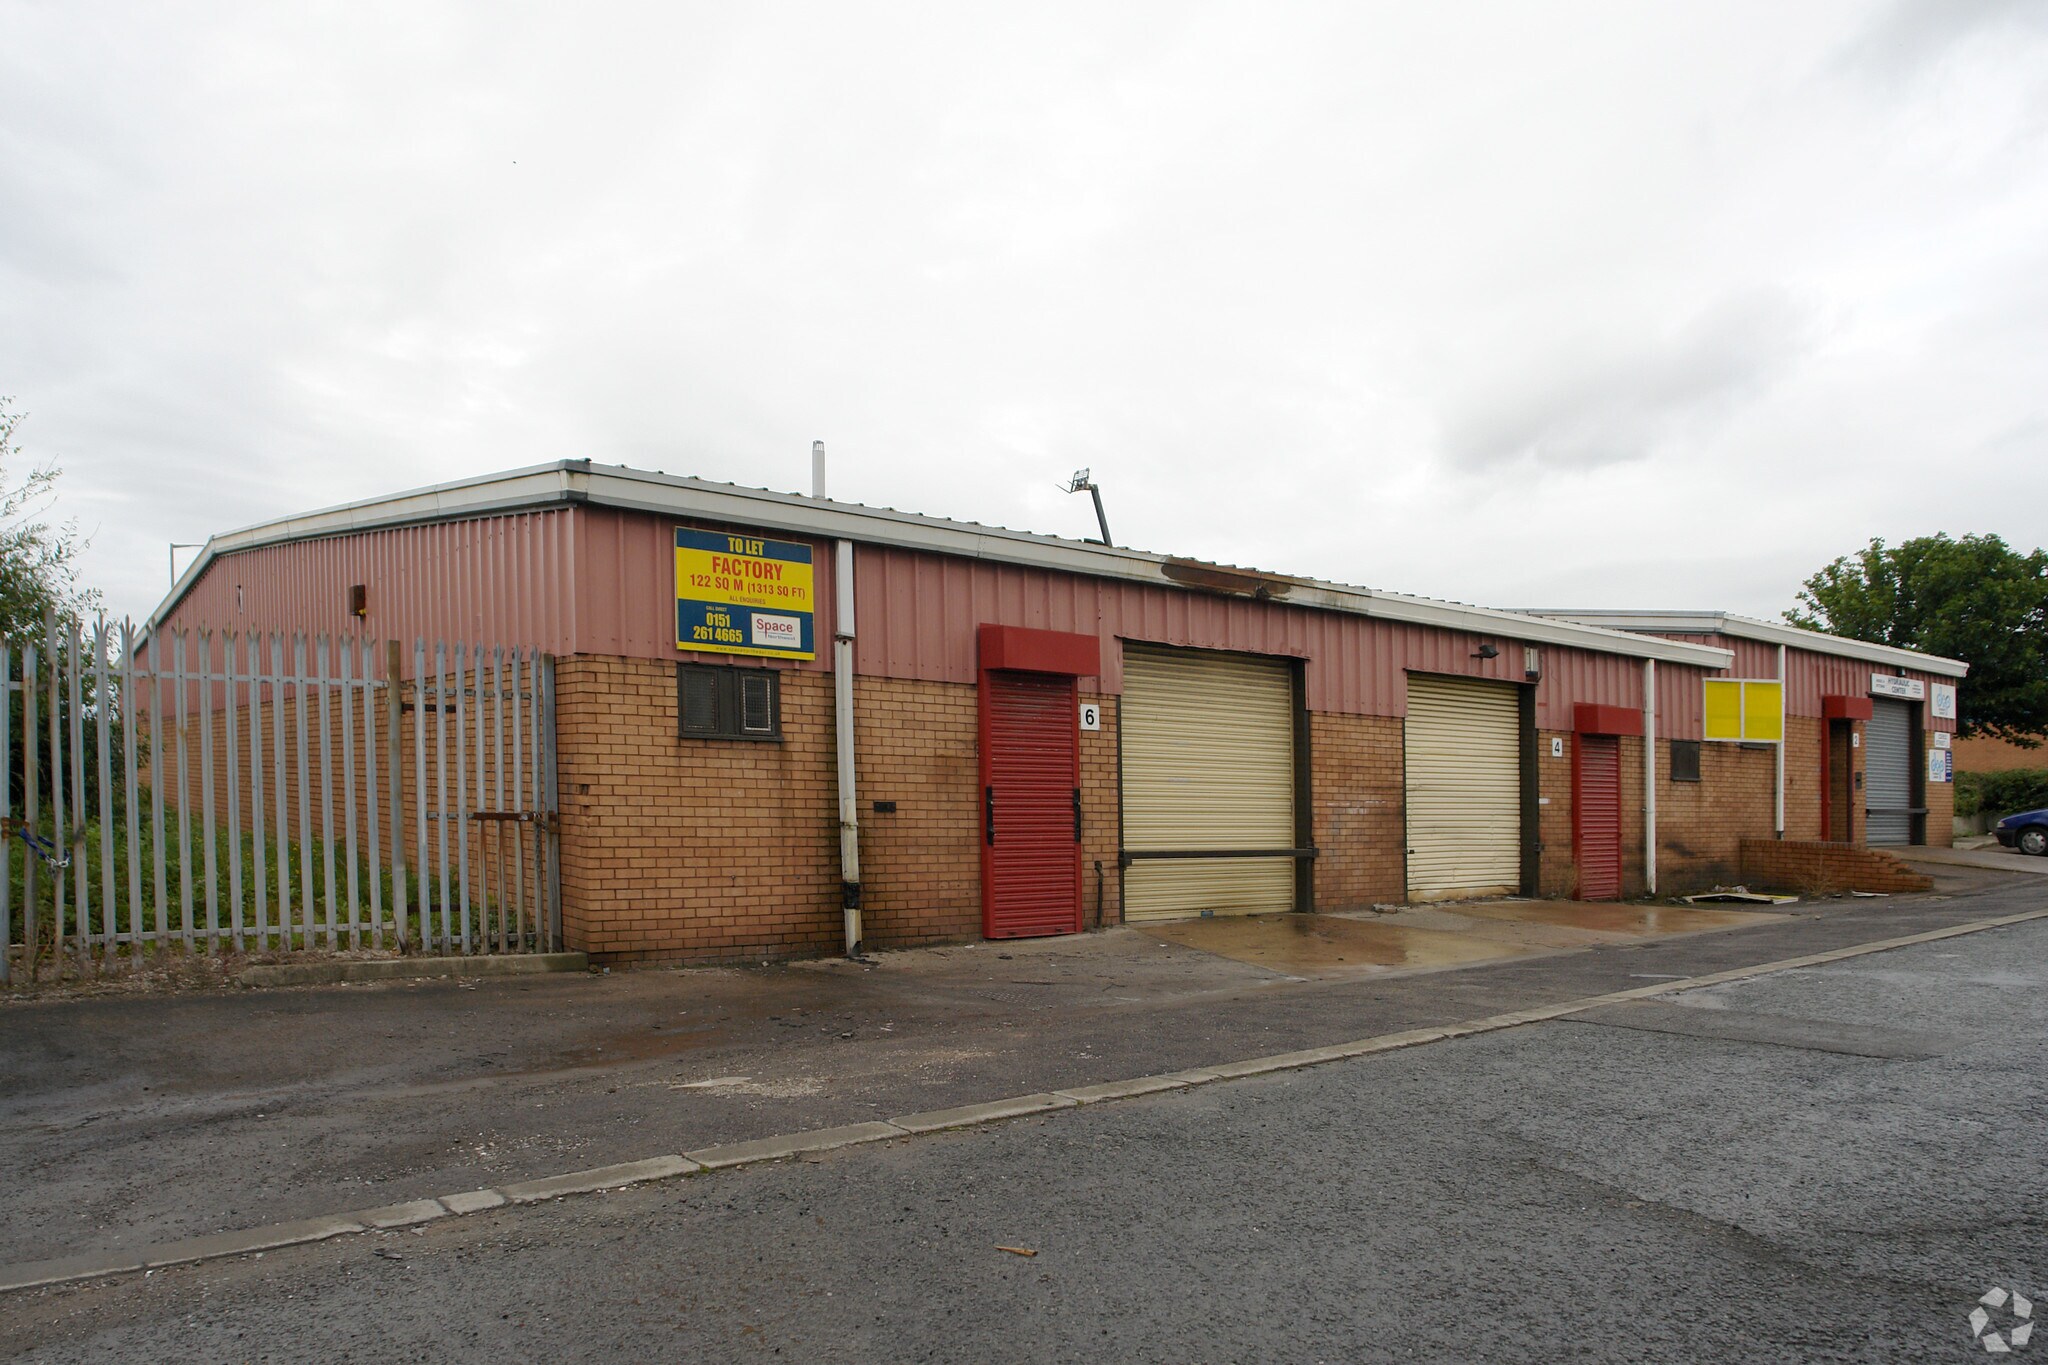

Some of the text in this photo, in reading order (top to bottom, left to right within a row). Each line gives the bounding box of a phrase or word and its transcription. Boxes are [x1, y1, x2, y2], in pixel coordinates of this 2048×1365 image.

[728, 537, 764, 556] TO LET
[712, 556, 783, 581] FACTORY
[690, 574, 806, 600] 122 SQ M (1313 SQ FT)
[739, 596, 766, 605] ENQUIRIES
[706, 612, 731, 627] 0151
[756, 618, 793, 639] Space
[693, 626, 743, 643] 261 4665
[1085, 708, 1095, 726] 6
[1554, 741, 1561, 753] 4
